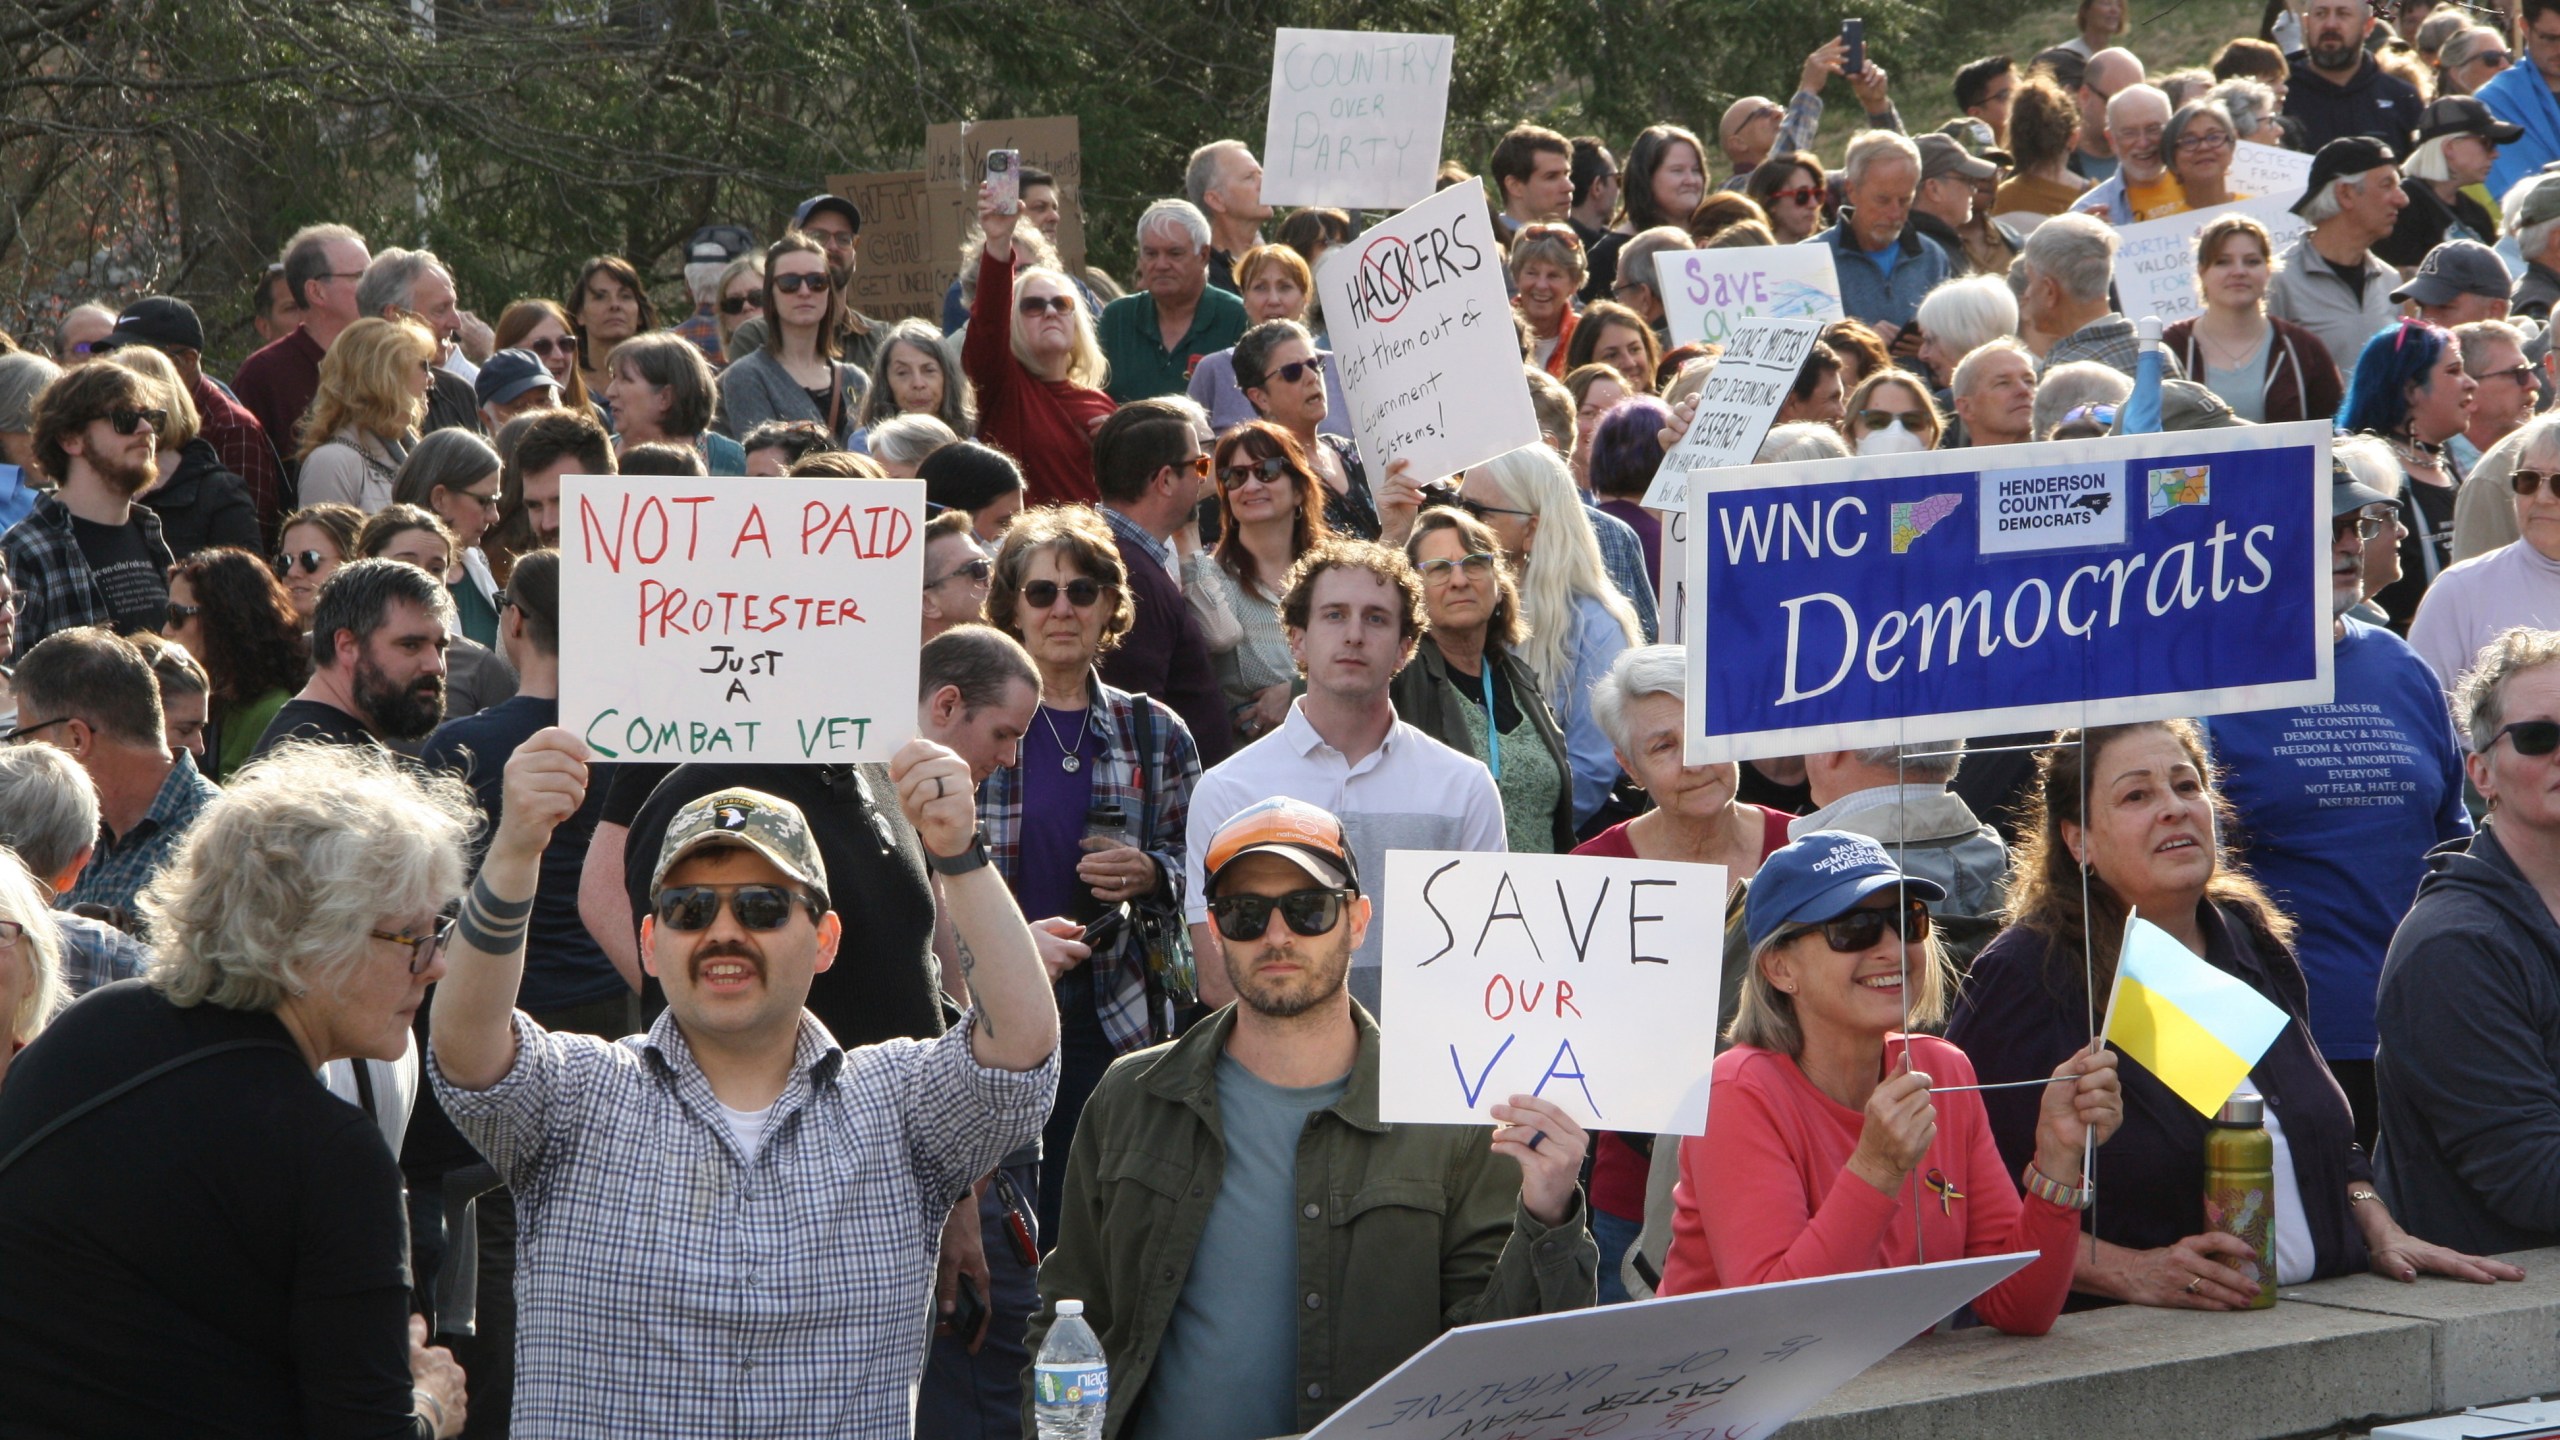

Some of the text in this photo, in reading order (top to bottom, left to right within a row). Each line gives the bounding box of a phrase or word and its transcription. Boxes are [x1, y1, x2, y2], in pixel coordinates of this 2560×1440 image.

[1284, 40, 1443, 92] COUNTRY
[1330, 94, 1385, 118] OVER
[1289, 111, 1413, 178] PARTY
[2251, 167, 2291, 181] FROM
[1346, 213, 1482, 329] HACKERS
[2133, 252, 2190, 275] VALOR
[2149, 296, 2199, 317] PAR
[1342, 298, 1483, 391] Get them out of
[1361, 370, 1443, 434] Government
[1700, 377, 1728, 402] STOP
[1376, 401, 1445, 466] Systems!
[1689, 411, 1751, 451] RESEARCH
[1999, 473, 2106, 497] HENDERSON
[1998, 493, 2101, 515] COUNTY NC
[580, 492, 913, 573] NOT A PAID
[1719, 495, 1869, 566] WNC
[1999, 511, 2092, 531] DEMOCRATS
[638, 579, 867, 646] PROTESTER
[1775, 520, 2275, 707] Democrats
[724, 678, 751, 703] A
[2301, 703, 2381, 715] VETERANS FOR
[585, 708, 872, 759] COMBAT VET
[2291, 716, 2395, 728] THE CONSTITUTION
[2283, 729, 2408, 742] DEMOCRACY & JUSTICE
[2273, 742, 2422, 757] FREEDOM & VOTING RIGHTS
[2296, 755, 2416, 767] WOMEN, MINORITIES,
[2328, 768, 2391, 780] EVERYONE
[2305, 781, 2416, 795] NOT FEAR, HATE OR
[714, 798, 755, 808] AIRBORNE
[2318, 795, 2405, 808] INSURRECTION
[1276, 832, 1336, 853] nativesoutdoors
[1829, 842, 1865, 855] SAVE
[1830, 856, 1886, 874] AMERICA
[1417, 859, 1678, 968] SAVE
[1484, 973, 1583, 1021] OUR
[1449, 1033, 1603, 1120] VA
[1636, 1346, 1728, 1382] OF
[1367, 1362, 1617, 1430] UKRAINE
[1448, 1374, 1747, 1440] FASTER THAN
